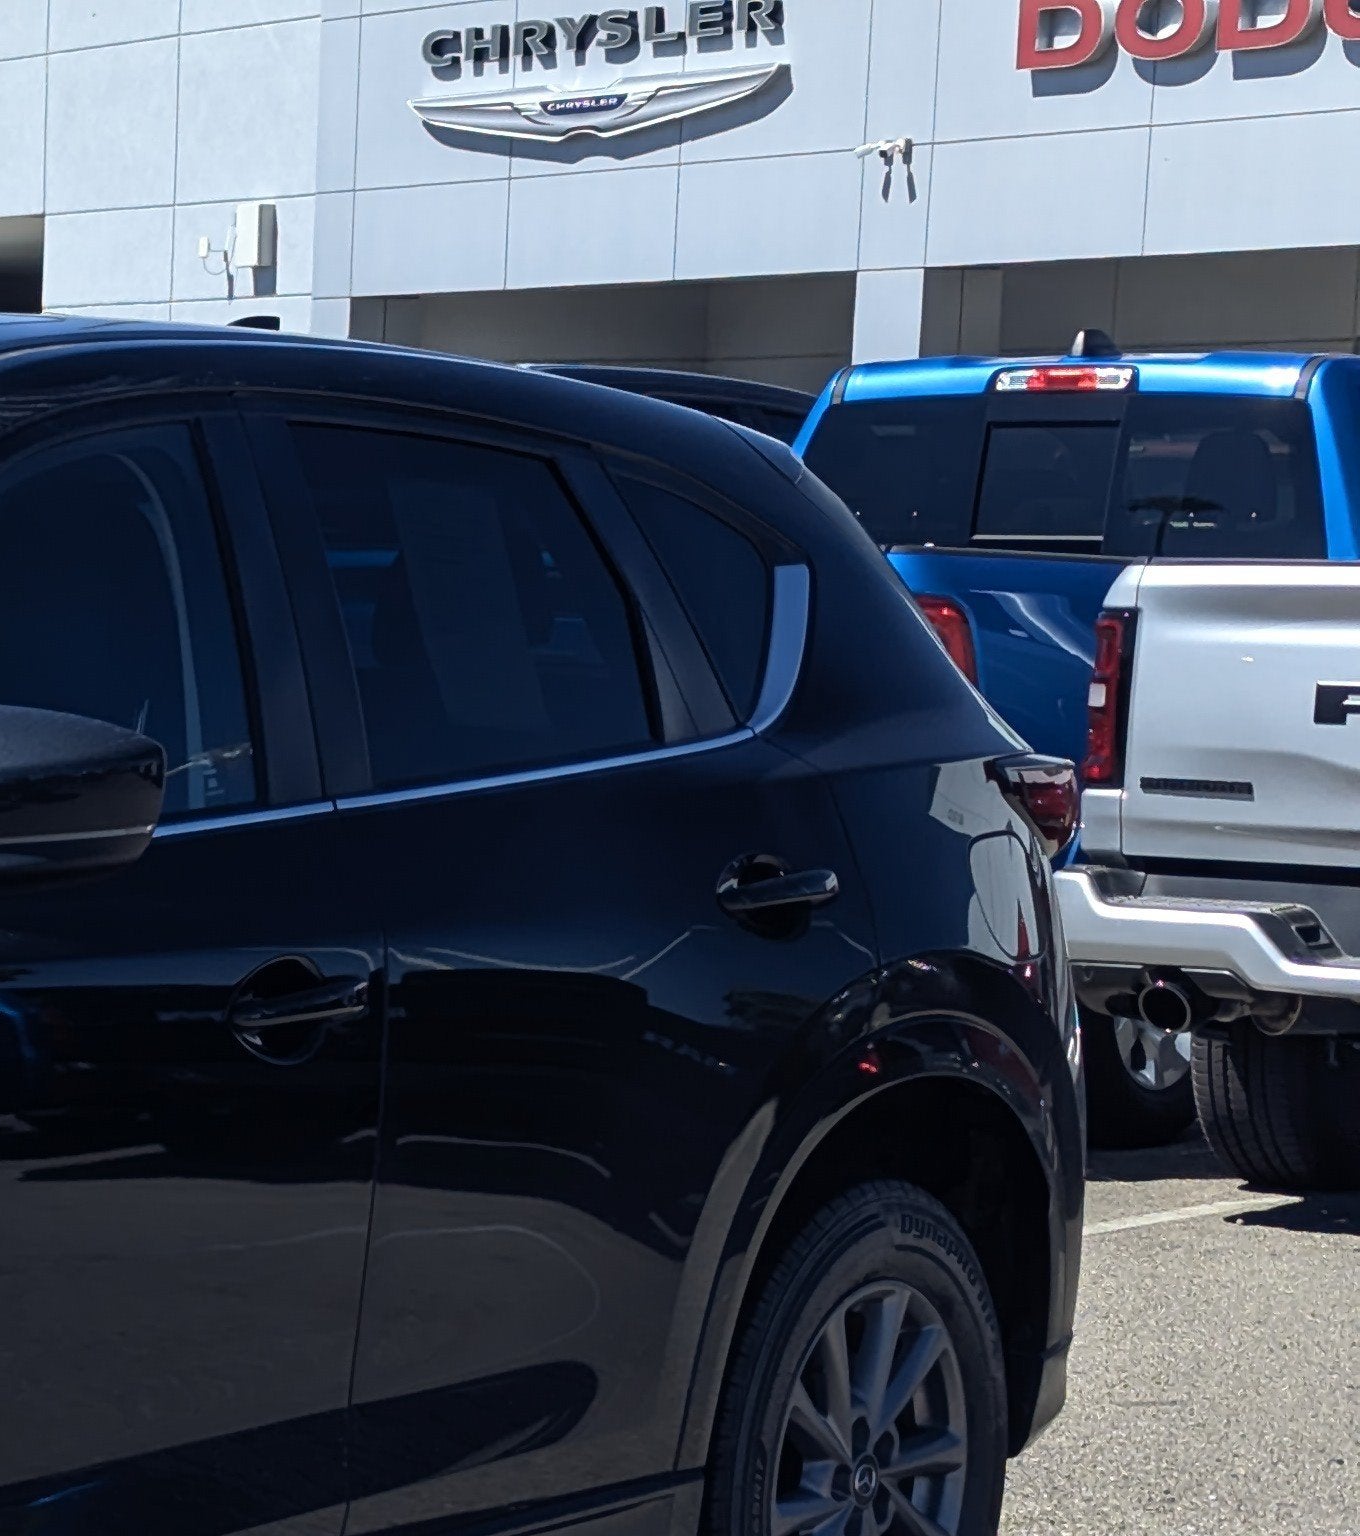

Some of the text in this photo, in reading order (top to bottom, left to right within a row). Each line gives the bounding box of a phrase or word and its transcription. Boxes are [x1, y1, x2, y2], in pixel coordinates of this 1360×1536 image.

[421, 0, 776, 66] CHRYSLER
[1015, 0, 1360, 71] DOD
[545, 96, 620, 112] CHRYSLER
